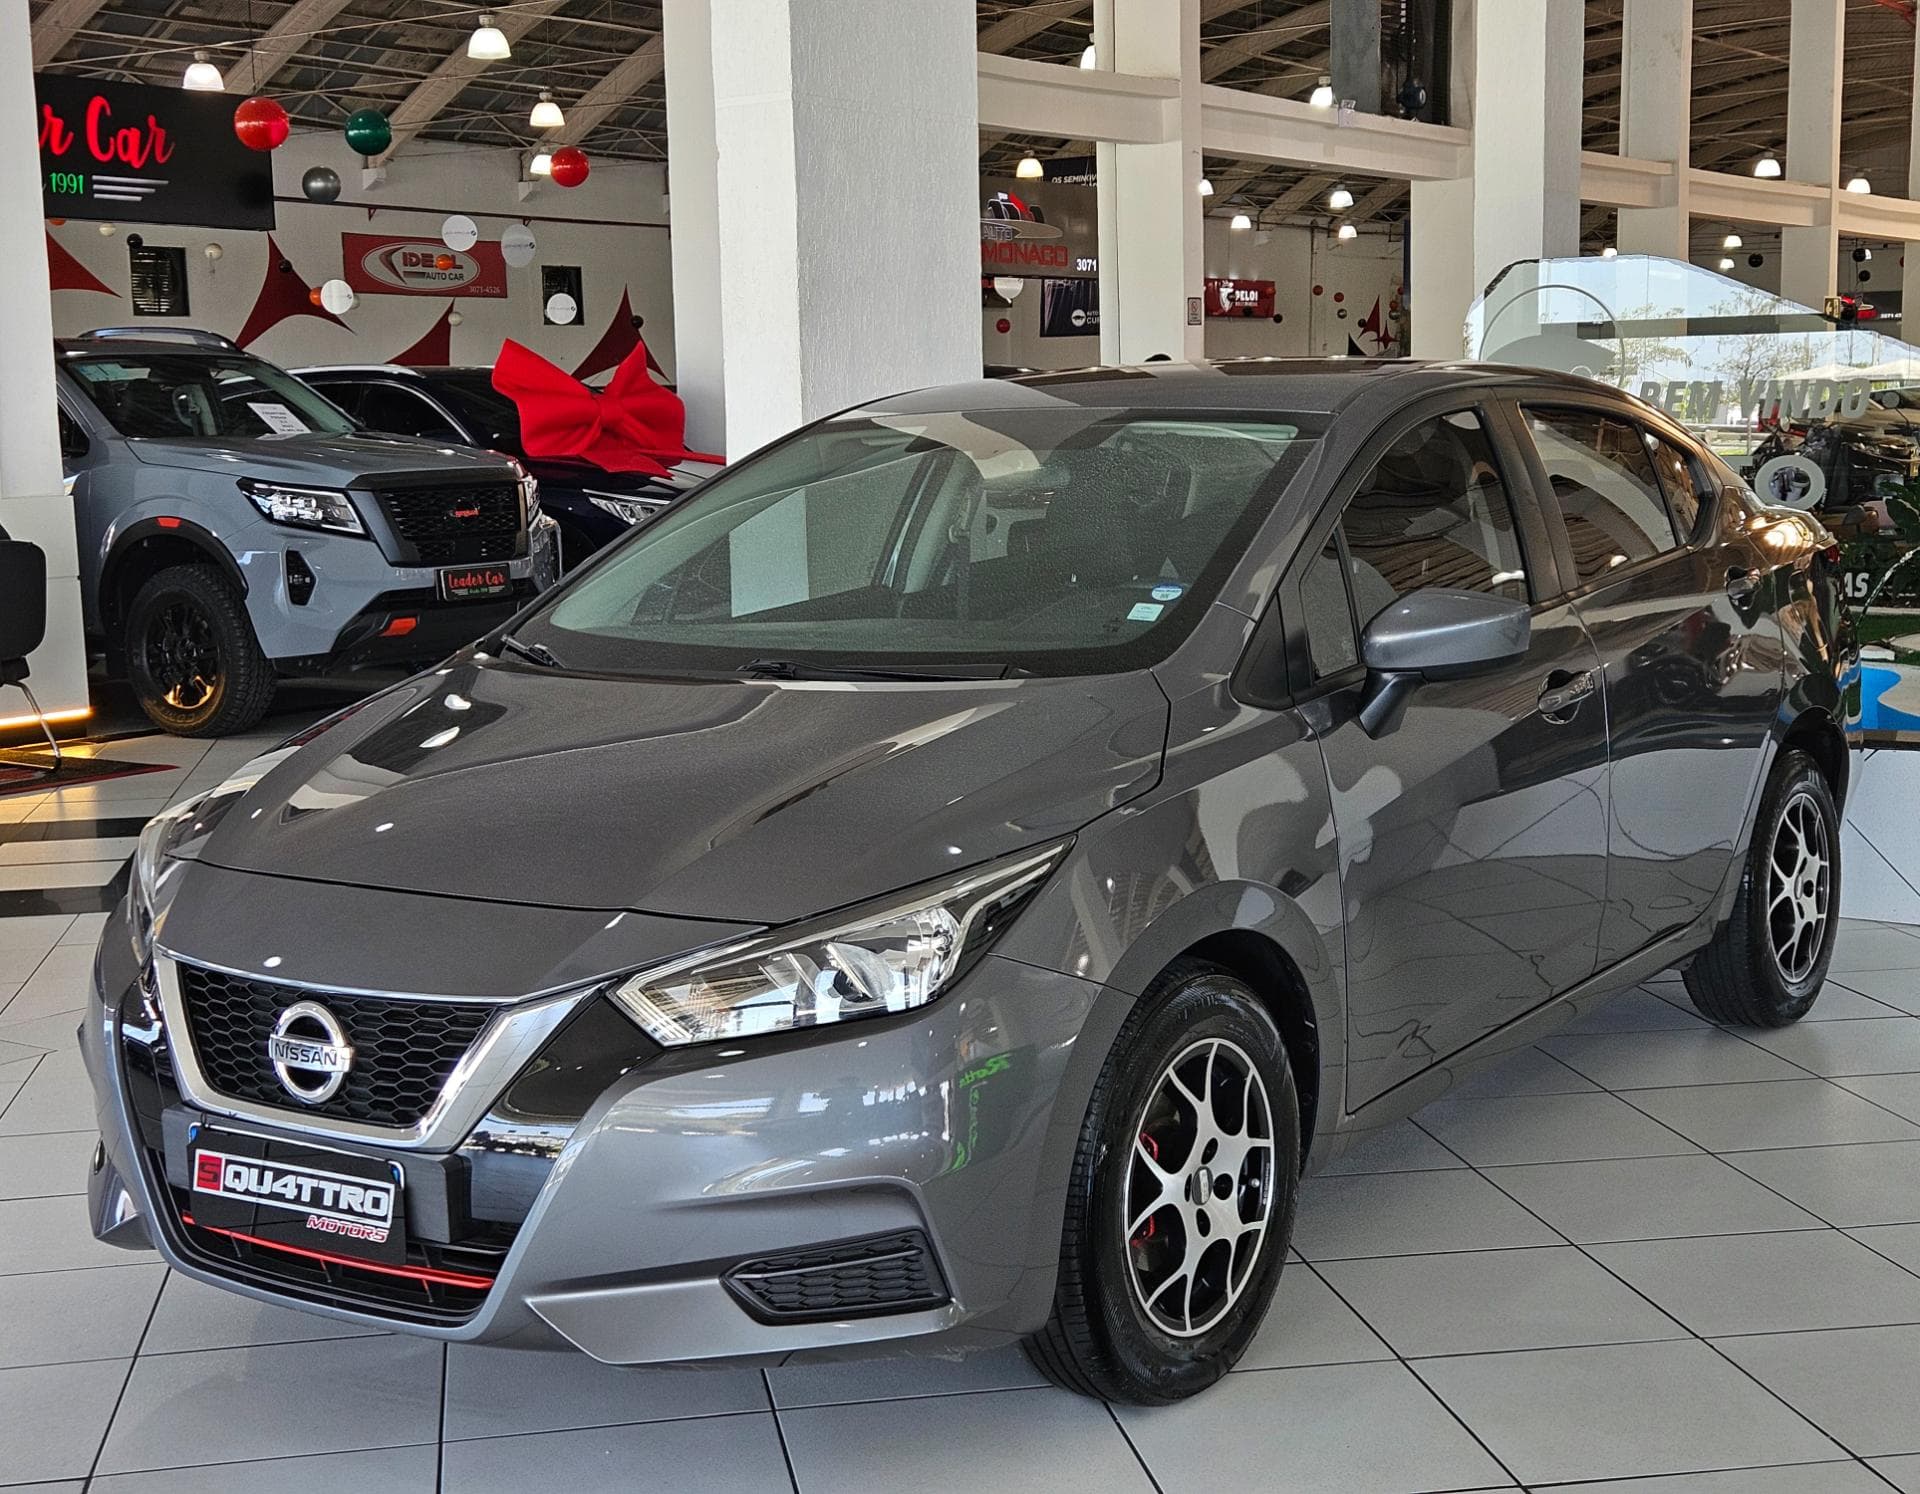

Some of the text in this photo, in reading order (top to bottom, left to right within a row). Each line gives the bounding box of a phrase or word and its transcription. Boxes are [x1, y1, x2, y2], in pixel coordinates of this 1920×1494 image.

[86, 95, 175, 169] Car
[50, 171, 84, 194] 1991
[402, 251, 464, 270] IDEL
[1076, 258, 1097, 271] 3071
[425, 271, 465, 281] AUTO CAR
[1639, 377, 1871, 420] BEM VINDO
[447, 571, 484, 588] Leader
[485, 570, 506, 585] Car
[273, 1042, 338, 1067] NISSAN
[306, 1214, 390, 1243] MOTORS
